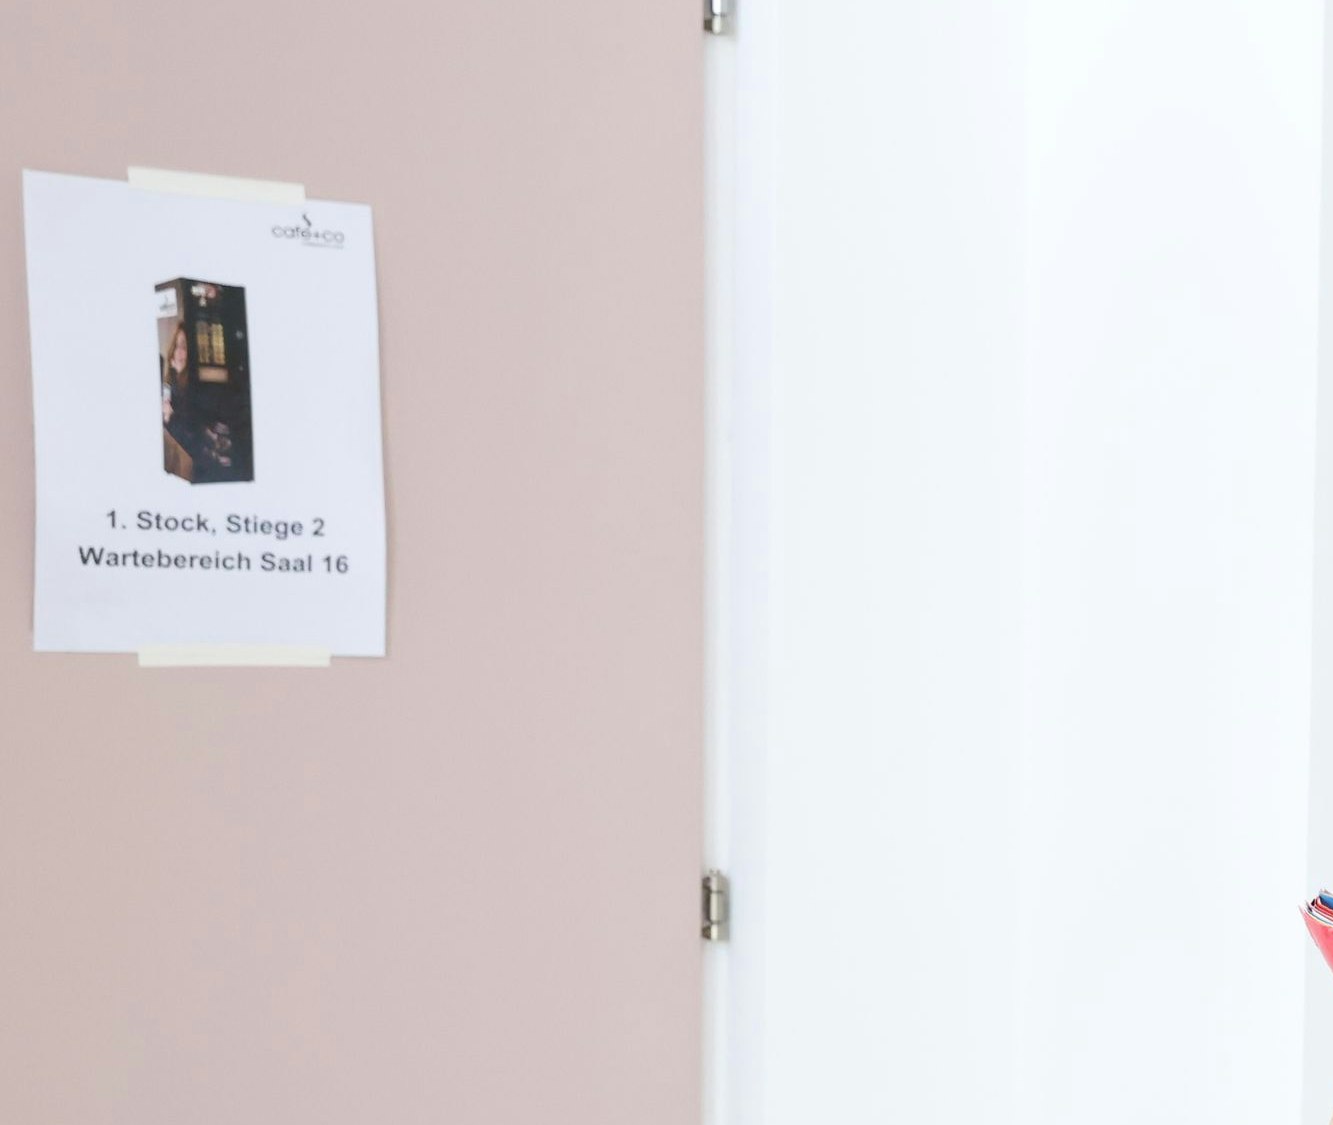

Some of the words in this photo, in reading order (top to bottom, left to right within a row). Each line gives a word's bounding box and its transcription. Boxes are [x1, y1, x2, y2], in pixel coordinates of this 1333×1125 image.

[106, 510, 127, 530] 1.
[137, 511, 217, 536] Stock,
[226, 514, 304, 540] Stiege
[312, 518, 325, 537] 2
[78, 545, 251, 571] Wartebereich
[260, 552, 313, 573] Saal
[322, 555, 349, 574] 16
